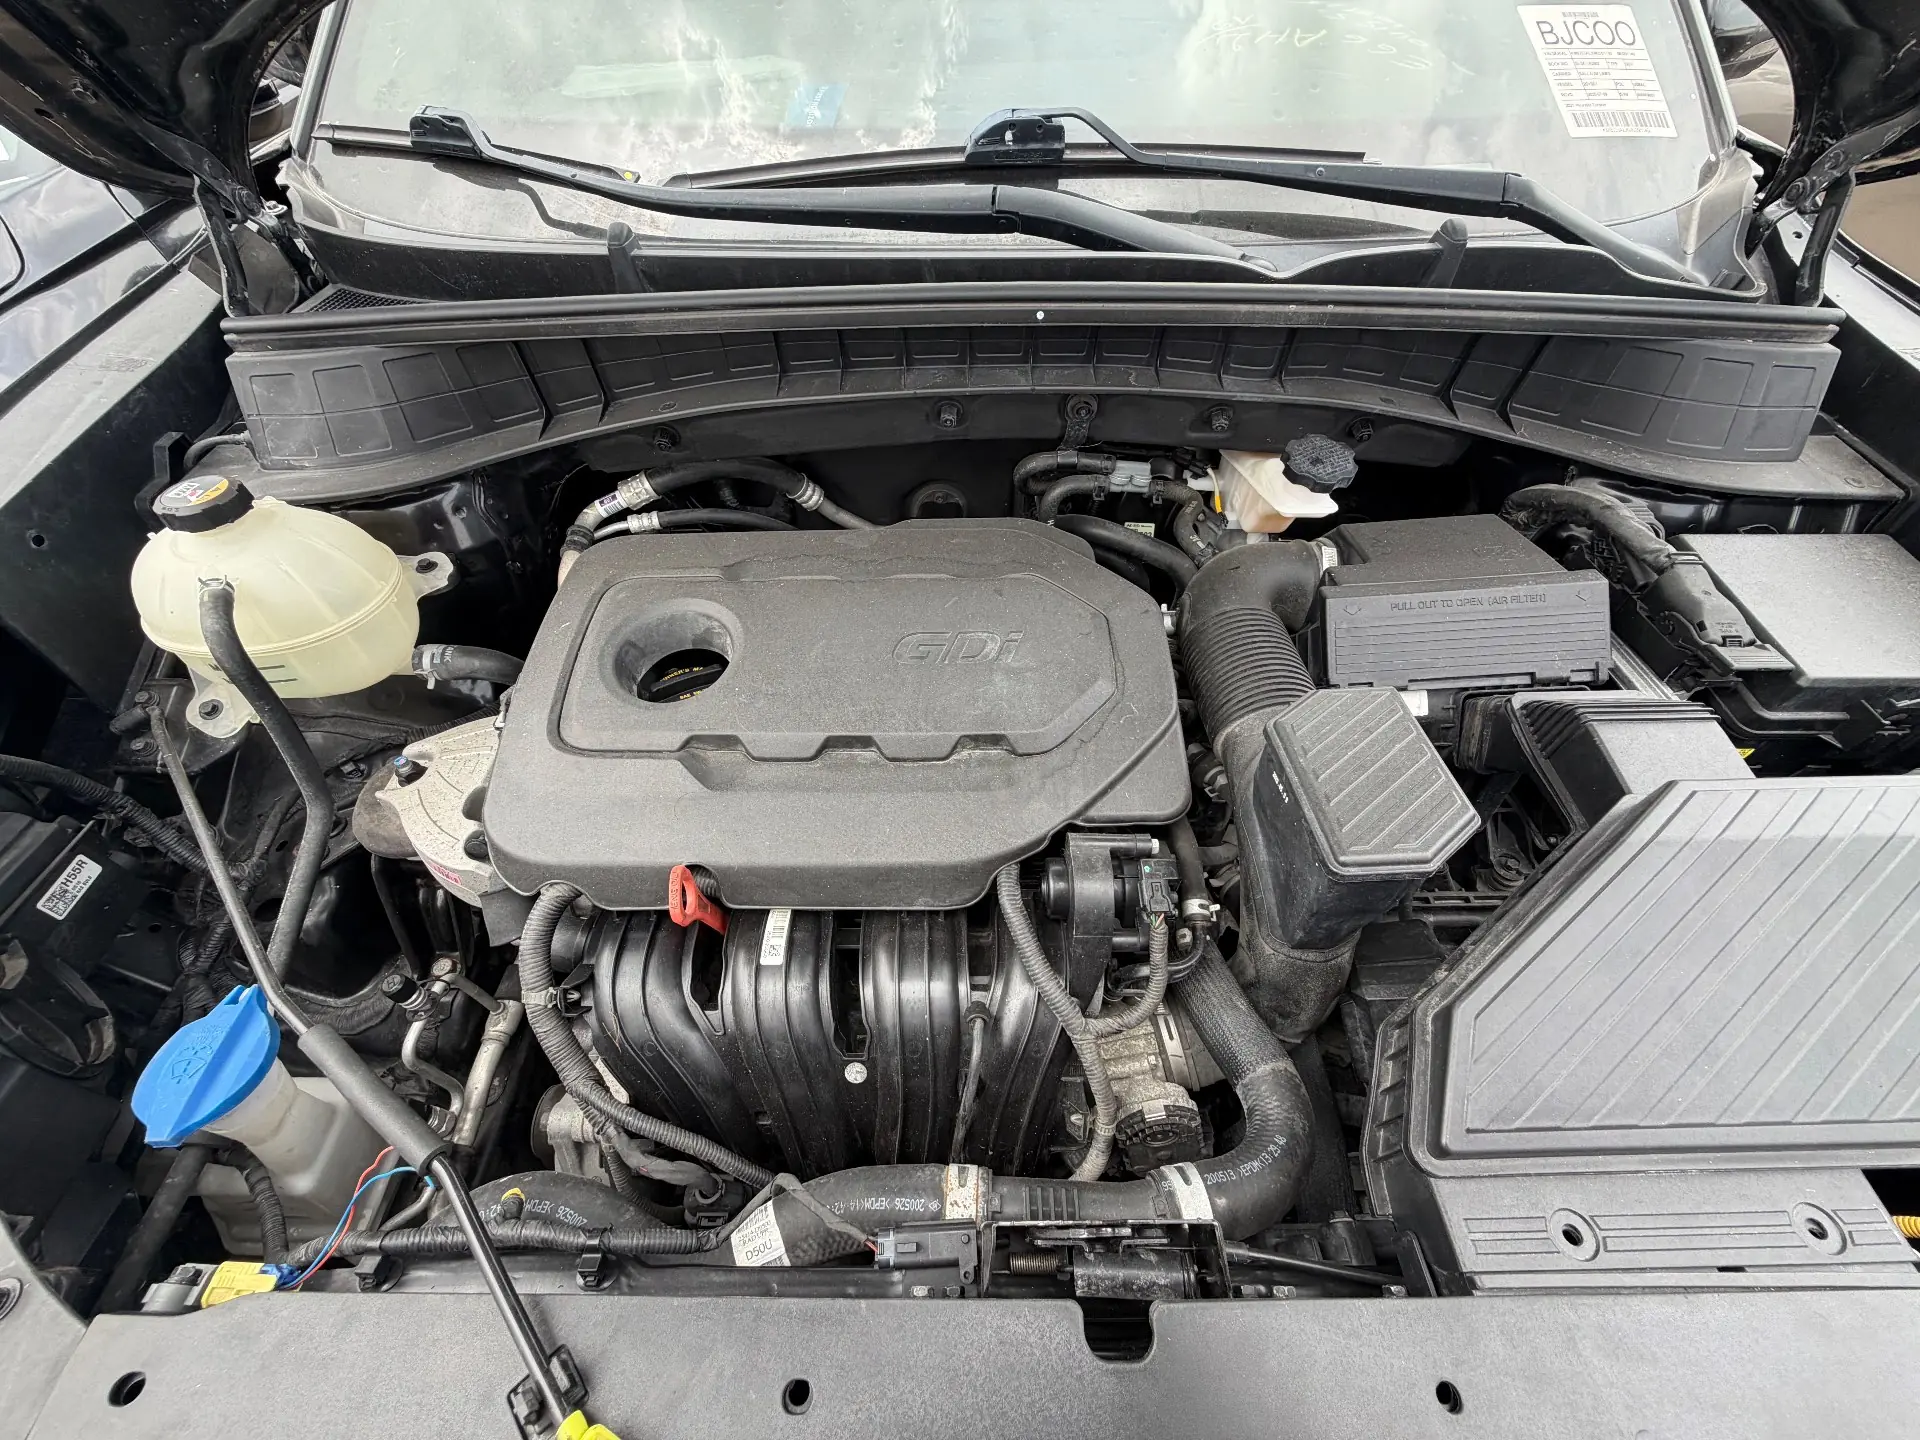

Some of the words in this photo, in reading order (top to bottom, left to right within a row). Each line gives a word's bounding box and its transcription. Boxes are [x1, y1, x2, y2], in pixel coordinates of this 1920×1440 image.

[1390, 602, 1416, 611] PULL
[1417, 600, 1438, 610] OUT
[1442, 599, 1453, 608] TO
[1456, 597, 1484, 607] OPEN
[892, 630, 1024, 664] GDi
[61, 859, 88, 888] H55R
[1204, 1169, 1237, 1185] 200513
[894, 1201, 926, 1212] 200526
